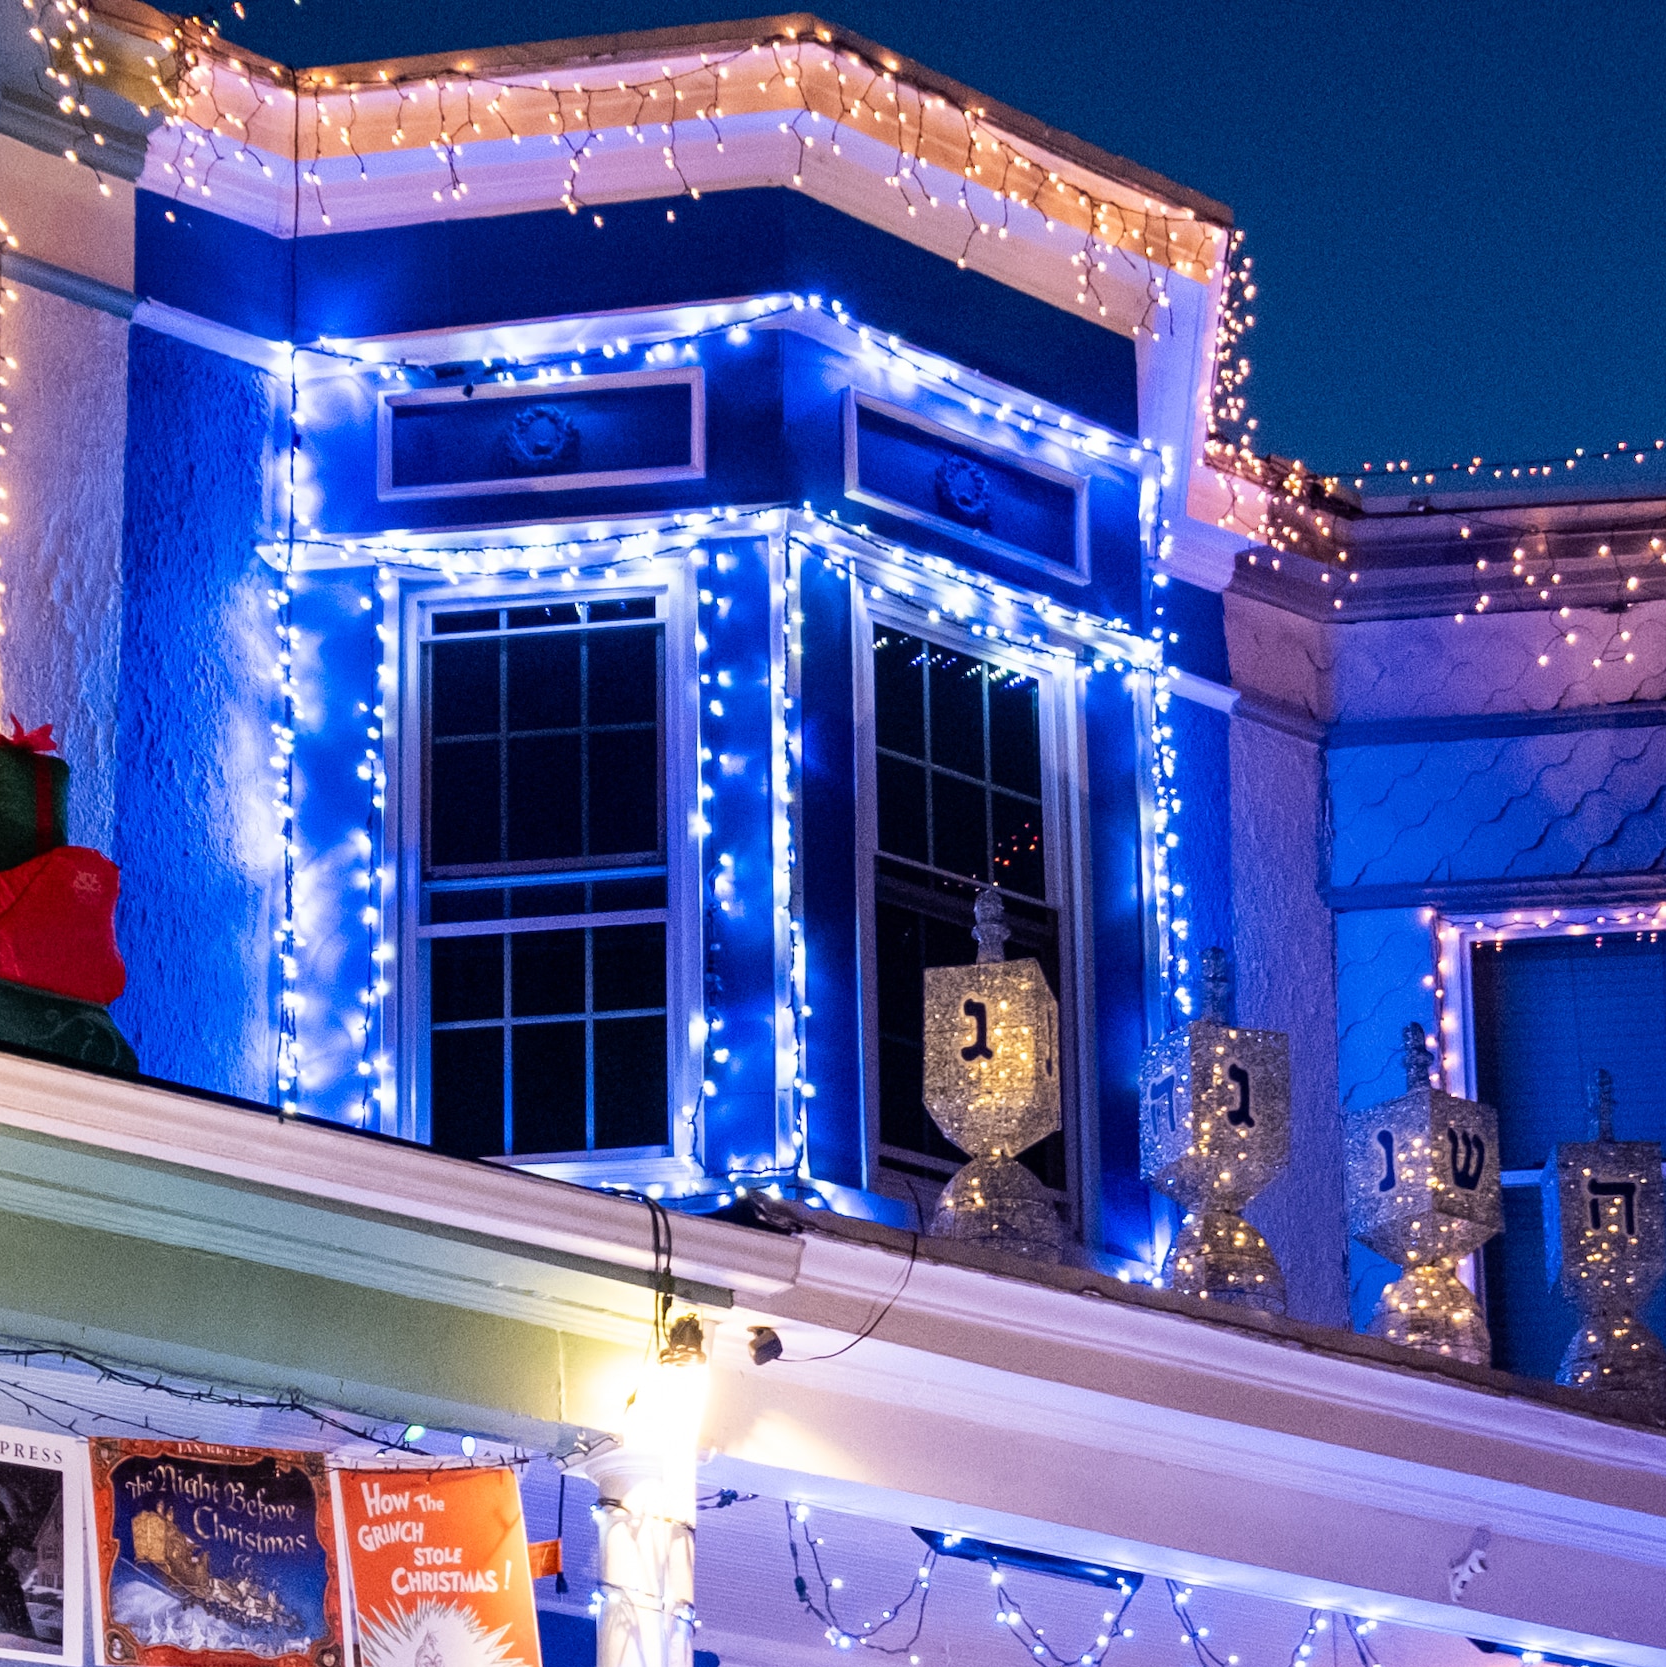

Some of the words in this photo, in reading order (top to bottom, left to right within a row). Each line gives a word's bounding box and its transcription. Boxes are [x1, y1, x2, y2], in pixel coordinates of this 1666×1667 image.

[153, 1463, 220, 1503] Night
[224, 1481, 296, 1524] Before
[193, 1506, 307, 1554] Christmas
[357, 1521, 425, 1552] GRINCH
[413, 1546, 463, 1567] STOLE
